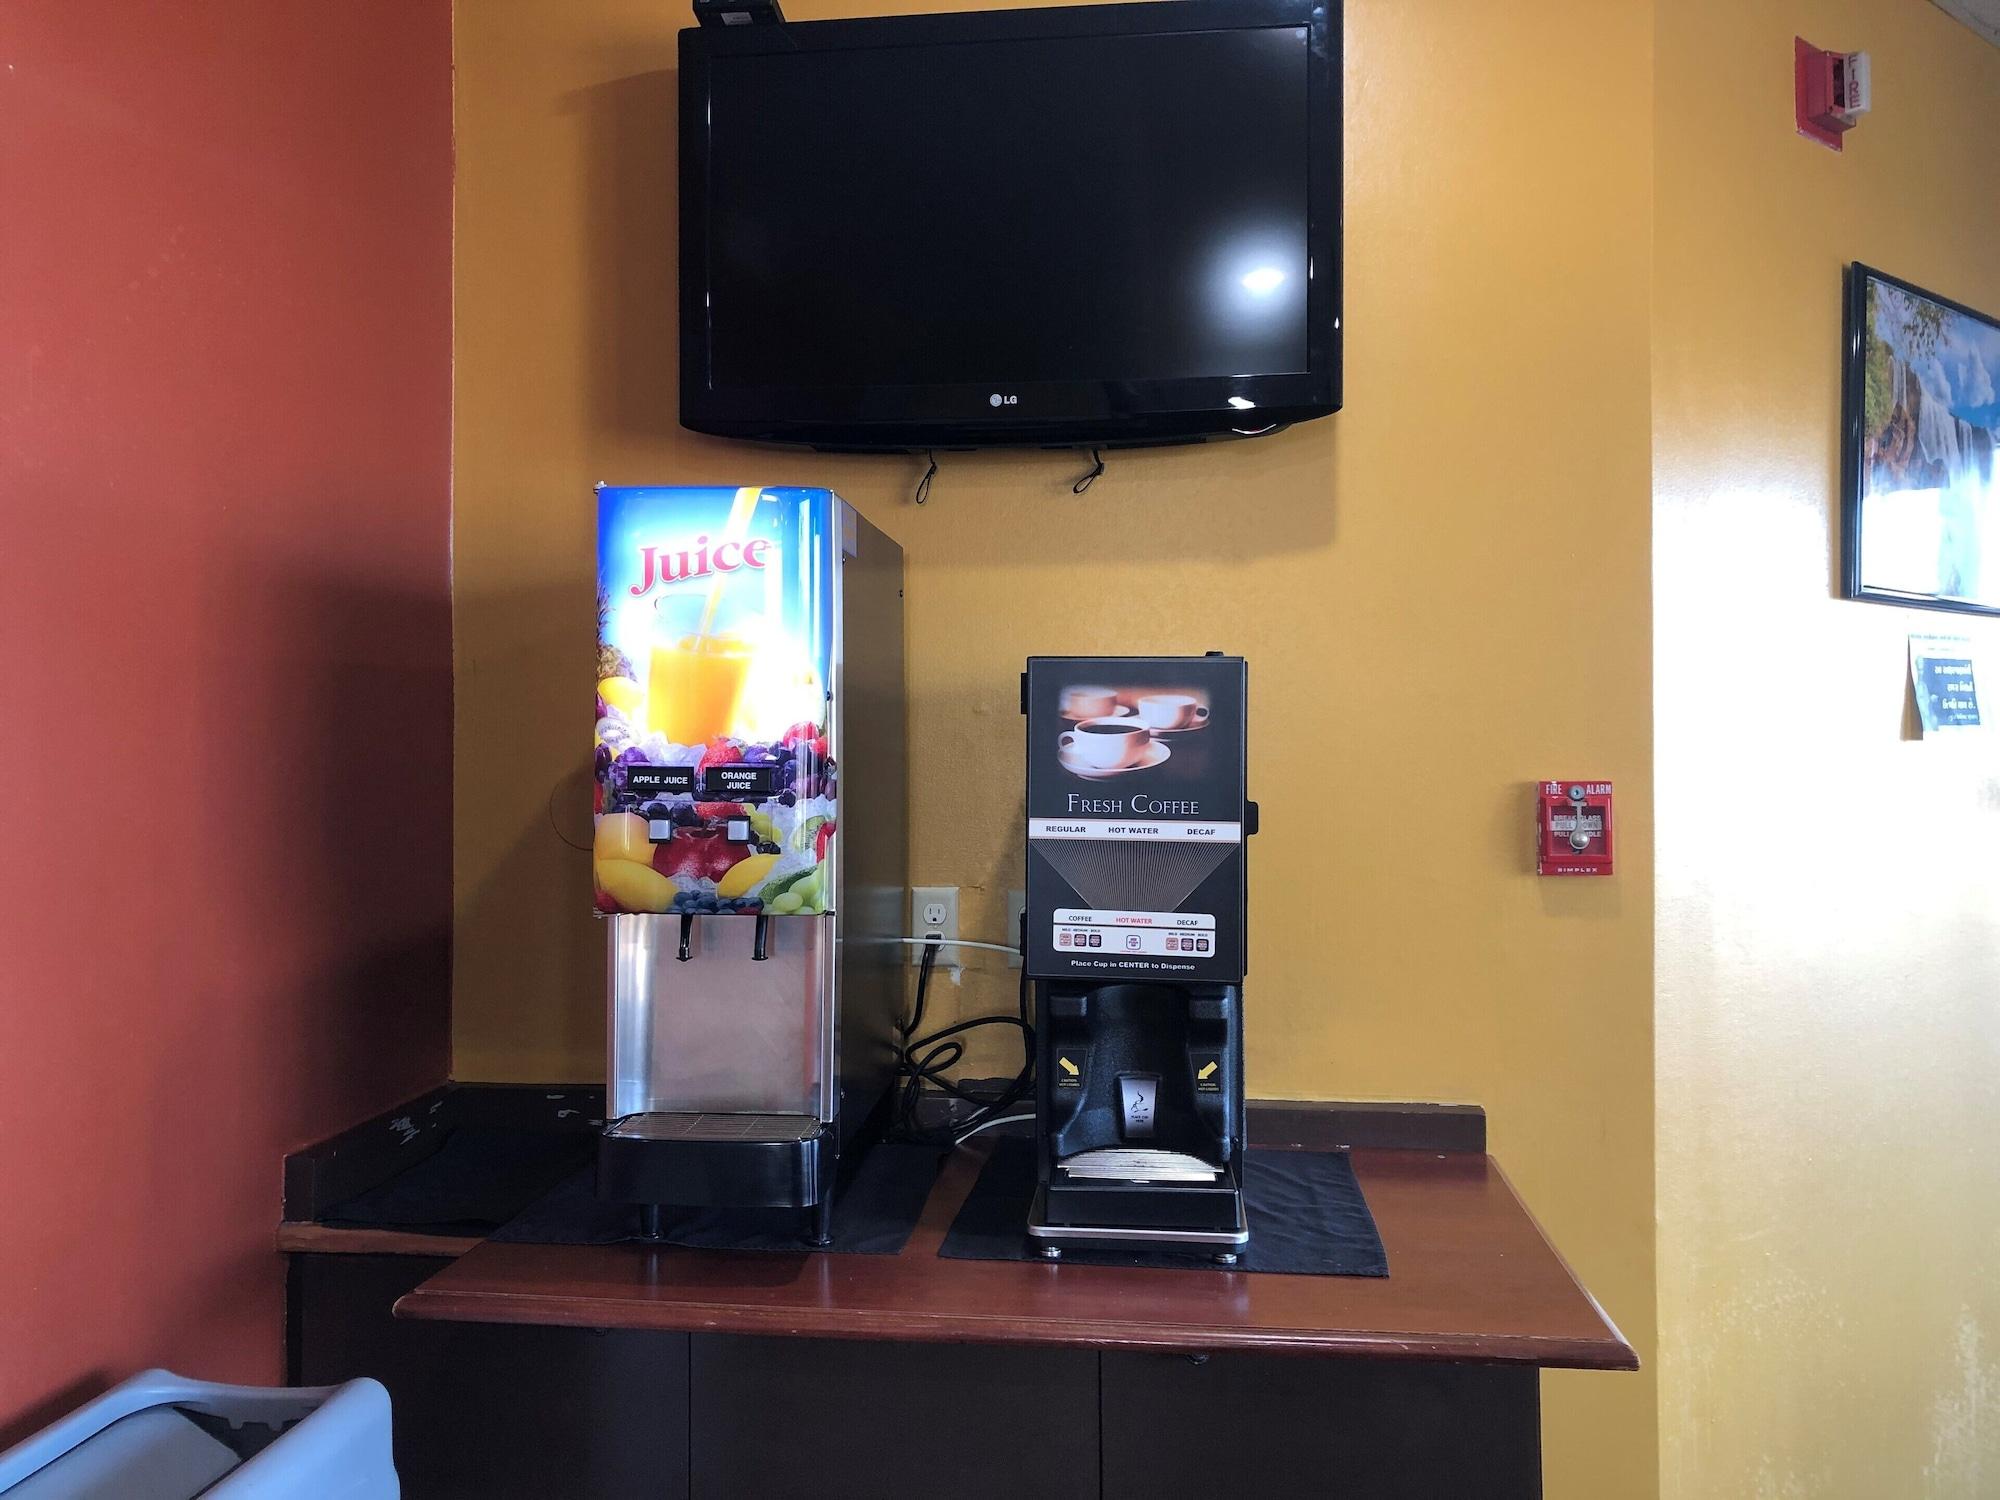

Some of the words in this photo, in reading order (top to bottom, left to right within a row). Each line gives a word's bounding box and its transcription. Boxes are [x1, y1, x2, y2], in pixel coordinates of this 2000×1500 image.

[1003, 395, 1018, 405] LG
[629, 534, 772, 597] Juice
[633, 775, 660, 785] APPLE
[664, 776, 688, 785] JUICE
[721, 771, 757, 781] ORANGE
[727, 781, 751, 790] JUICE
[1545, 784, 1563, 795] FIRE
[1586, 784, 1612, 795] ALARM
[1046, 825, 1086, 833] REGULAR
[1128, 827, 1159, 835] WATER
[1187, 828, 1216, 836] DECAF
[1093, 961, 1108, 969] Cup
